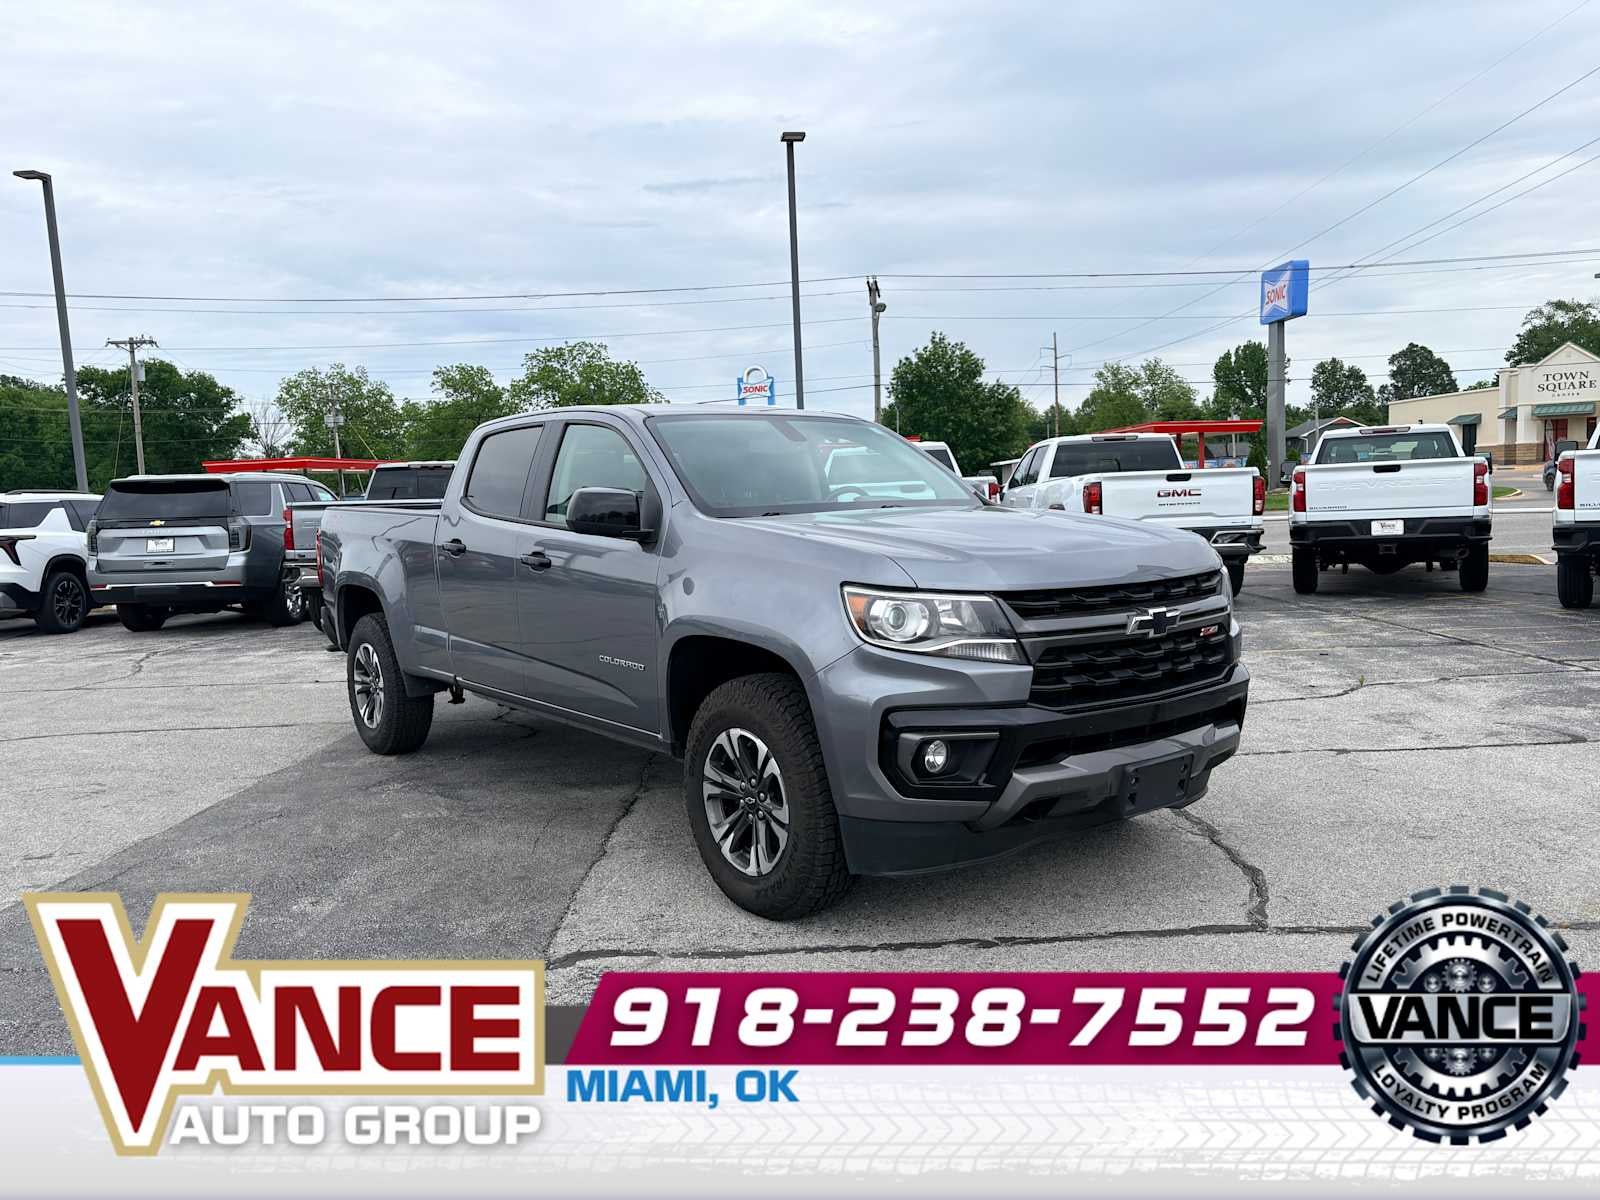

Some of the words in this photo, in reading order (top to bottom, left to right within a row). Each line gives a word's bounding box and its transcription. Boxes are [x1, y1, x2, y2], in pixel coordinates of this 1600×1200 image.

[1265, 284, 1286, 305] SONIC
[1543, 371, 1590, 382] TOWN
[743, 385, 768, 394] SONIC
[1537, 379, 1597, 393] SQUARE
[1157, 488, 1202, 498] GMC
[599, 654, 646, 671] COLORADO
